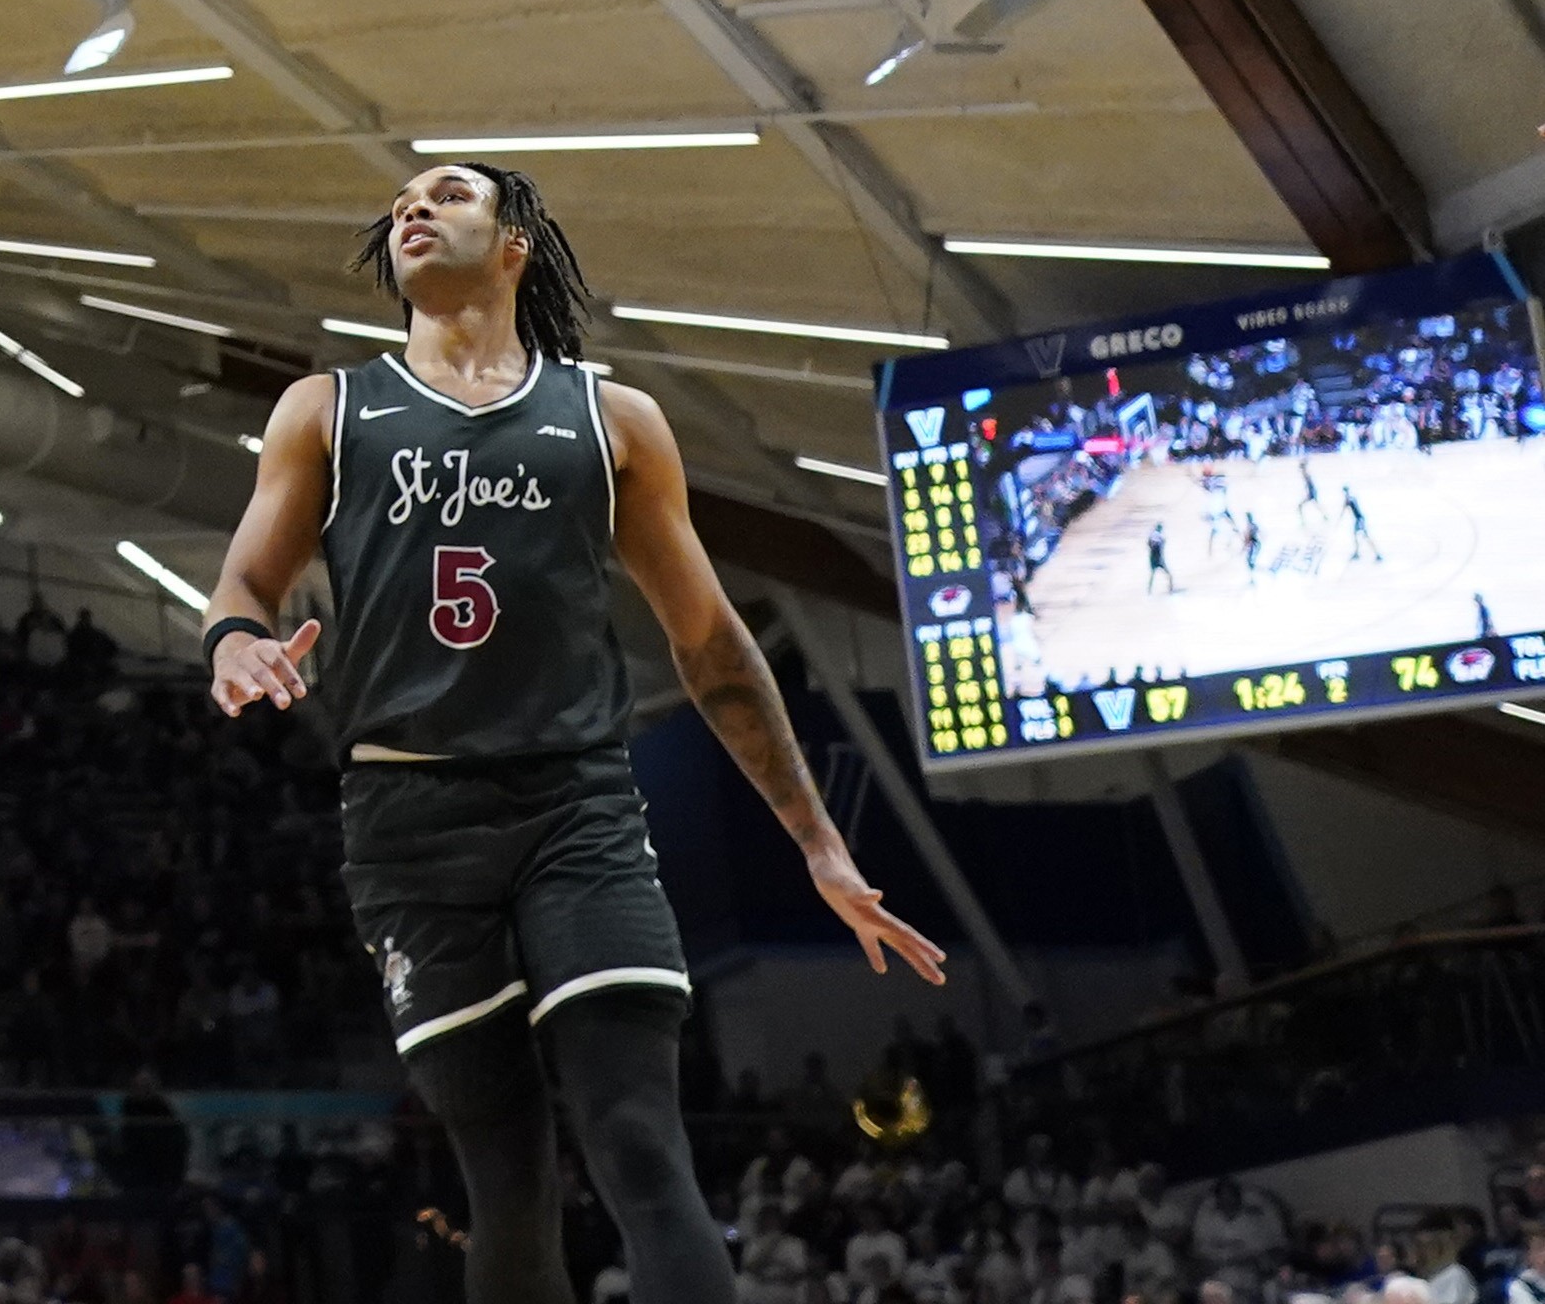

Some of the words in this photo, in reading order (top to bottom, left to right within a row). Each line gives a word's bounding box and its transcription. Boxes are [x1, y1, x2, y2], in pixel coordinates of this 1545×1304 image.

[1090, 322, 1183, 360] GRECO
[1236, 306, 1289, 331] VIDEO
[1293, 295, 1350, 321] BOARD
[388, 447, 442, 525] St.
[440, 449, 551, 527] Joe's
[429, 545, 501, 650] 5
[1233, 670, 1306, 711] 1:24
